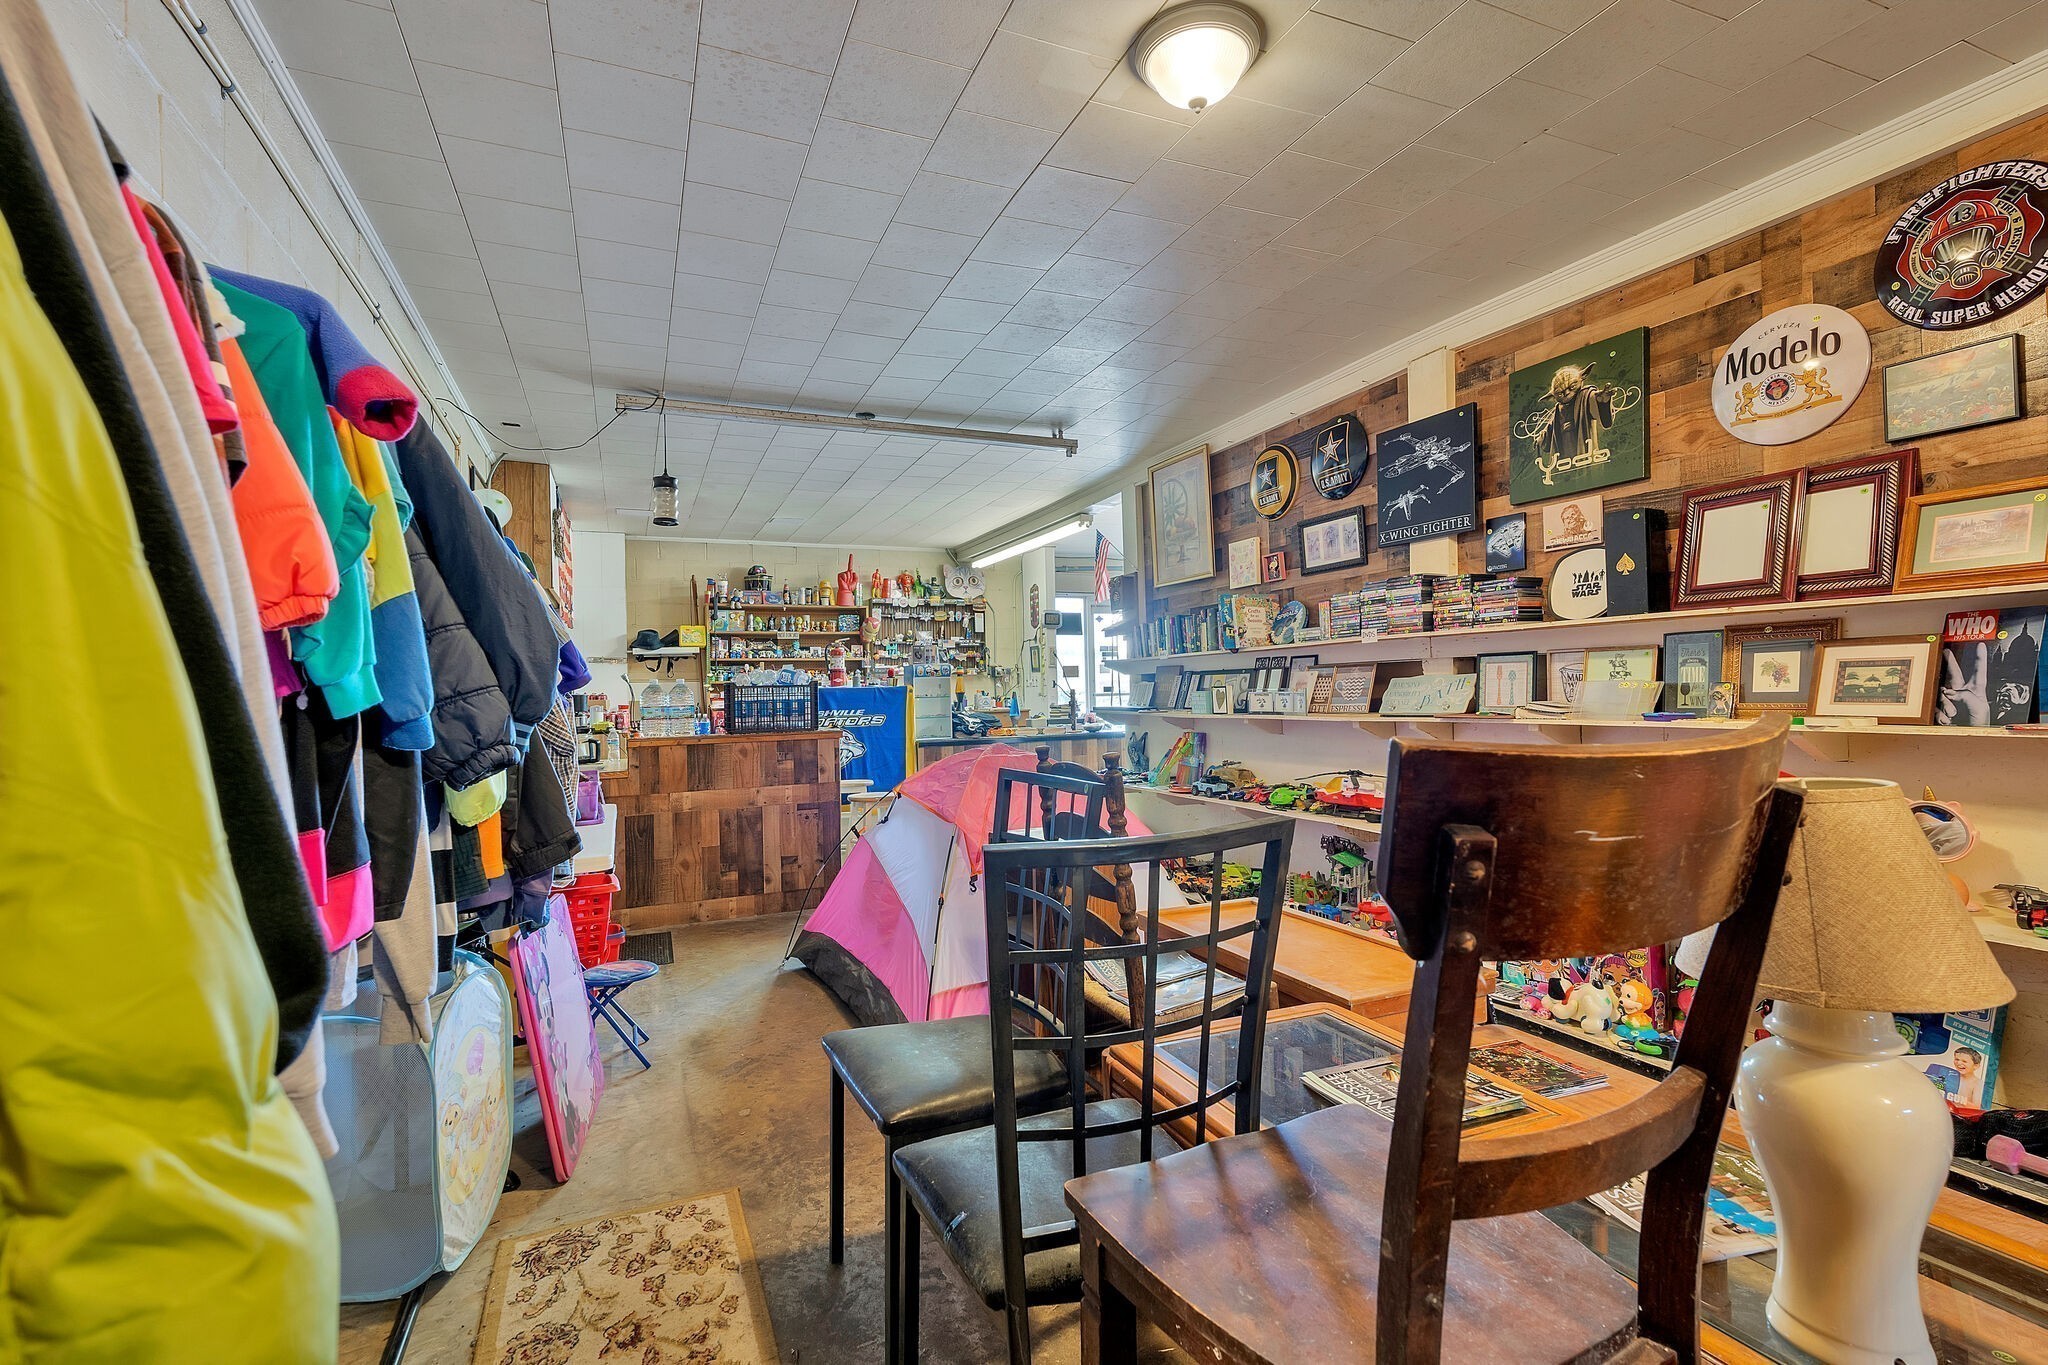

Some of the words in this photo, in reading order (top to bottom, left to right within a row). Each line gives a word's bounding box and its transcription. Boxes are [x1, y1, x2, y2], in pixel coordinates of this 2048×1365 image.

[1951, 206, 1973, 226] 13
[1996, 200, 2017, 216] FIRE
[1888, 296, 1923, 324] REAL
[1930, 302, 1994, 326] SUPER
[1758, 322, 1801, 340] CERVEZA
[1725, 326, 1842, 386] Modelo
[1535, 439, 1611, 485] Yoda
[1380, 526, 1419, 544] X-WING
[1423, 516, 1472, 534] FIGHTER
[1572, 588, 1600, 599] WARS
[1575, 582, 1602, 593] STAR
[1948, 615, 1996, 636] WHO
[819, 715, 886, 727] DATORS
[1953, 1021, 1962, 1029] It's
[1969, 1028, 1988, 1038] Shield
[1954, 1033, 1965, 1041] And
[1972, 1040, 1985, 1050] Gun!
